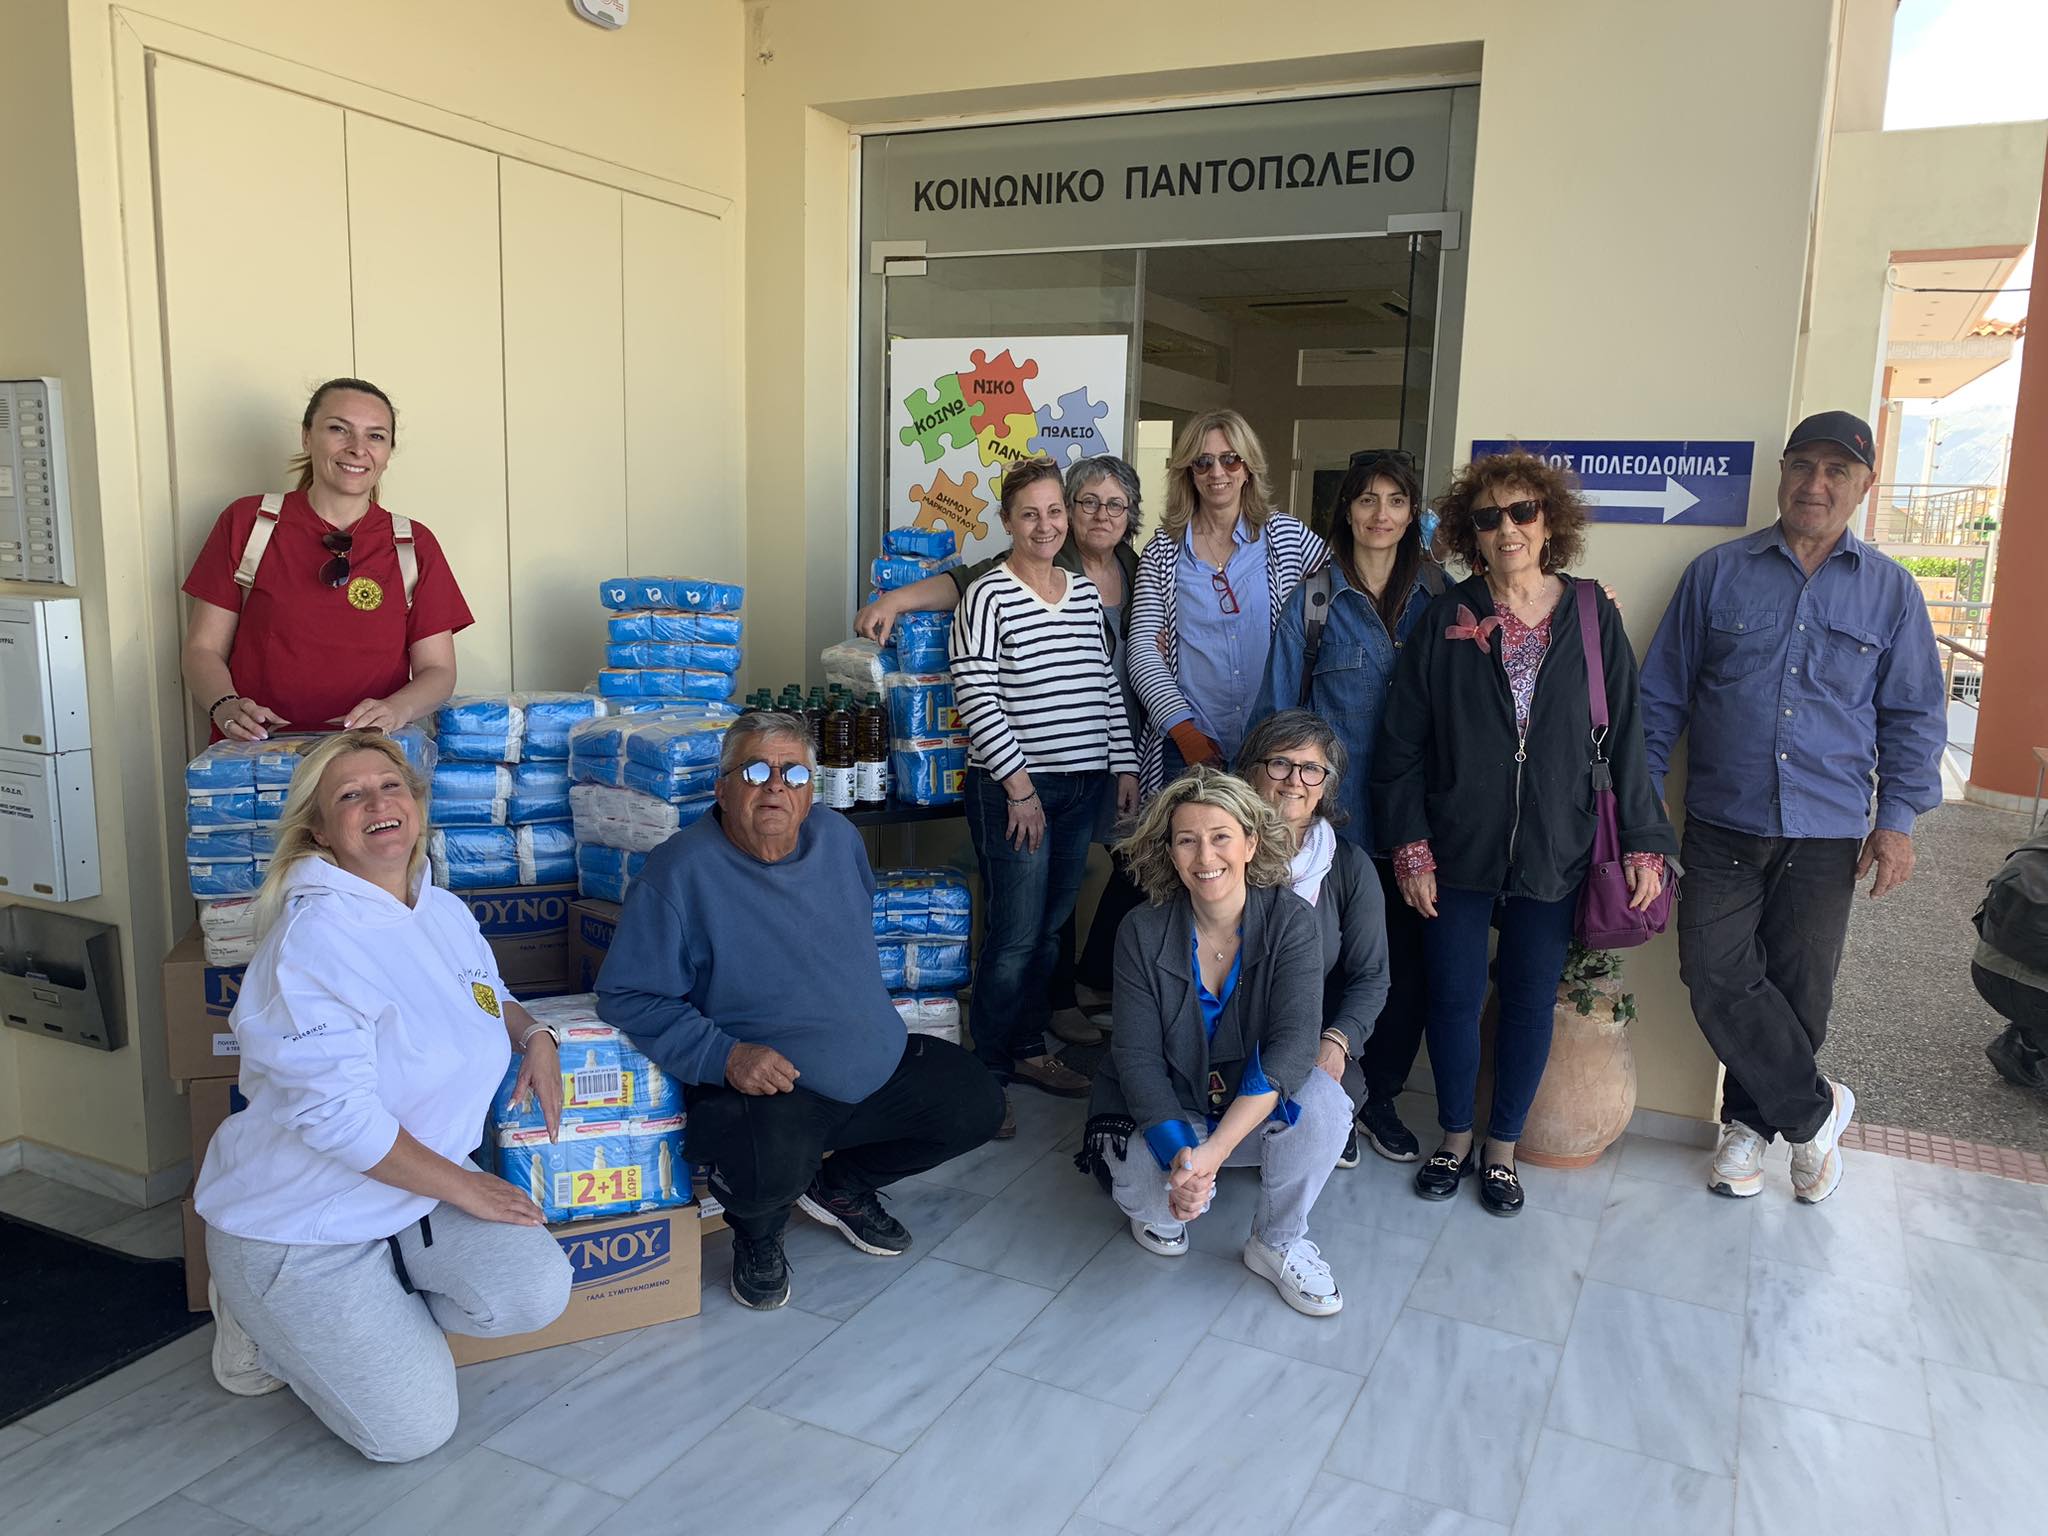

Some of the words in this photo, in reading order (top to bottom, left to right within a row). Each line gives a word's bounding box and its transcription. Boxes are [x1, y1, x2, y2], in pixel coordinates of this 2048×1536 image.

[913, 168, 1105, 213] ΚΟΙΝΩΝΙΚΟ
[1124, 145, 1416, 200] ΠΑΝΤΟΠΩΛΕΙΟ
[973, 379, 1015, 395] ΝΙΚΟ
[914, 399, 966, 435] ΚΟΙΝΩ
[1041, 426, 1094, 438] ΠΩΛΕΙΟ
[988, 440, 1034, 460] ΠΑΝΤ
[1580, 454, 1730, 476] ΠΟΛΕΟΔΟΜΙΑΣ
[922, 496, 976, 531] ΜΑΡΚΟΠΟΥΛΟΥ
[936, 492, 972, 516] ΔΗΜΟΥ
[470, 896, 573, 925] ΟΥΝΟ
[577, 1170, 626, 1204] 2+1
[629, 1168, 637, 1198] ΔΩΡΟ
[586, 1293, 605, 1302] ΓΑΛΑ
